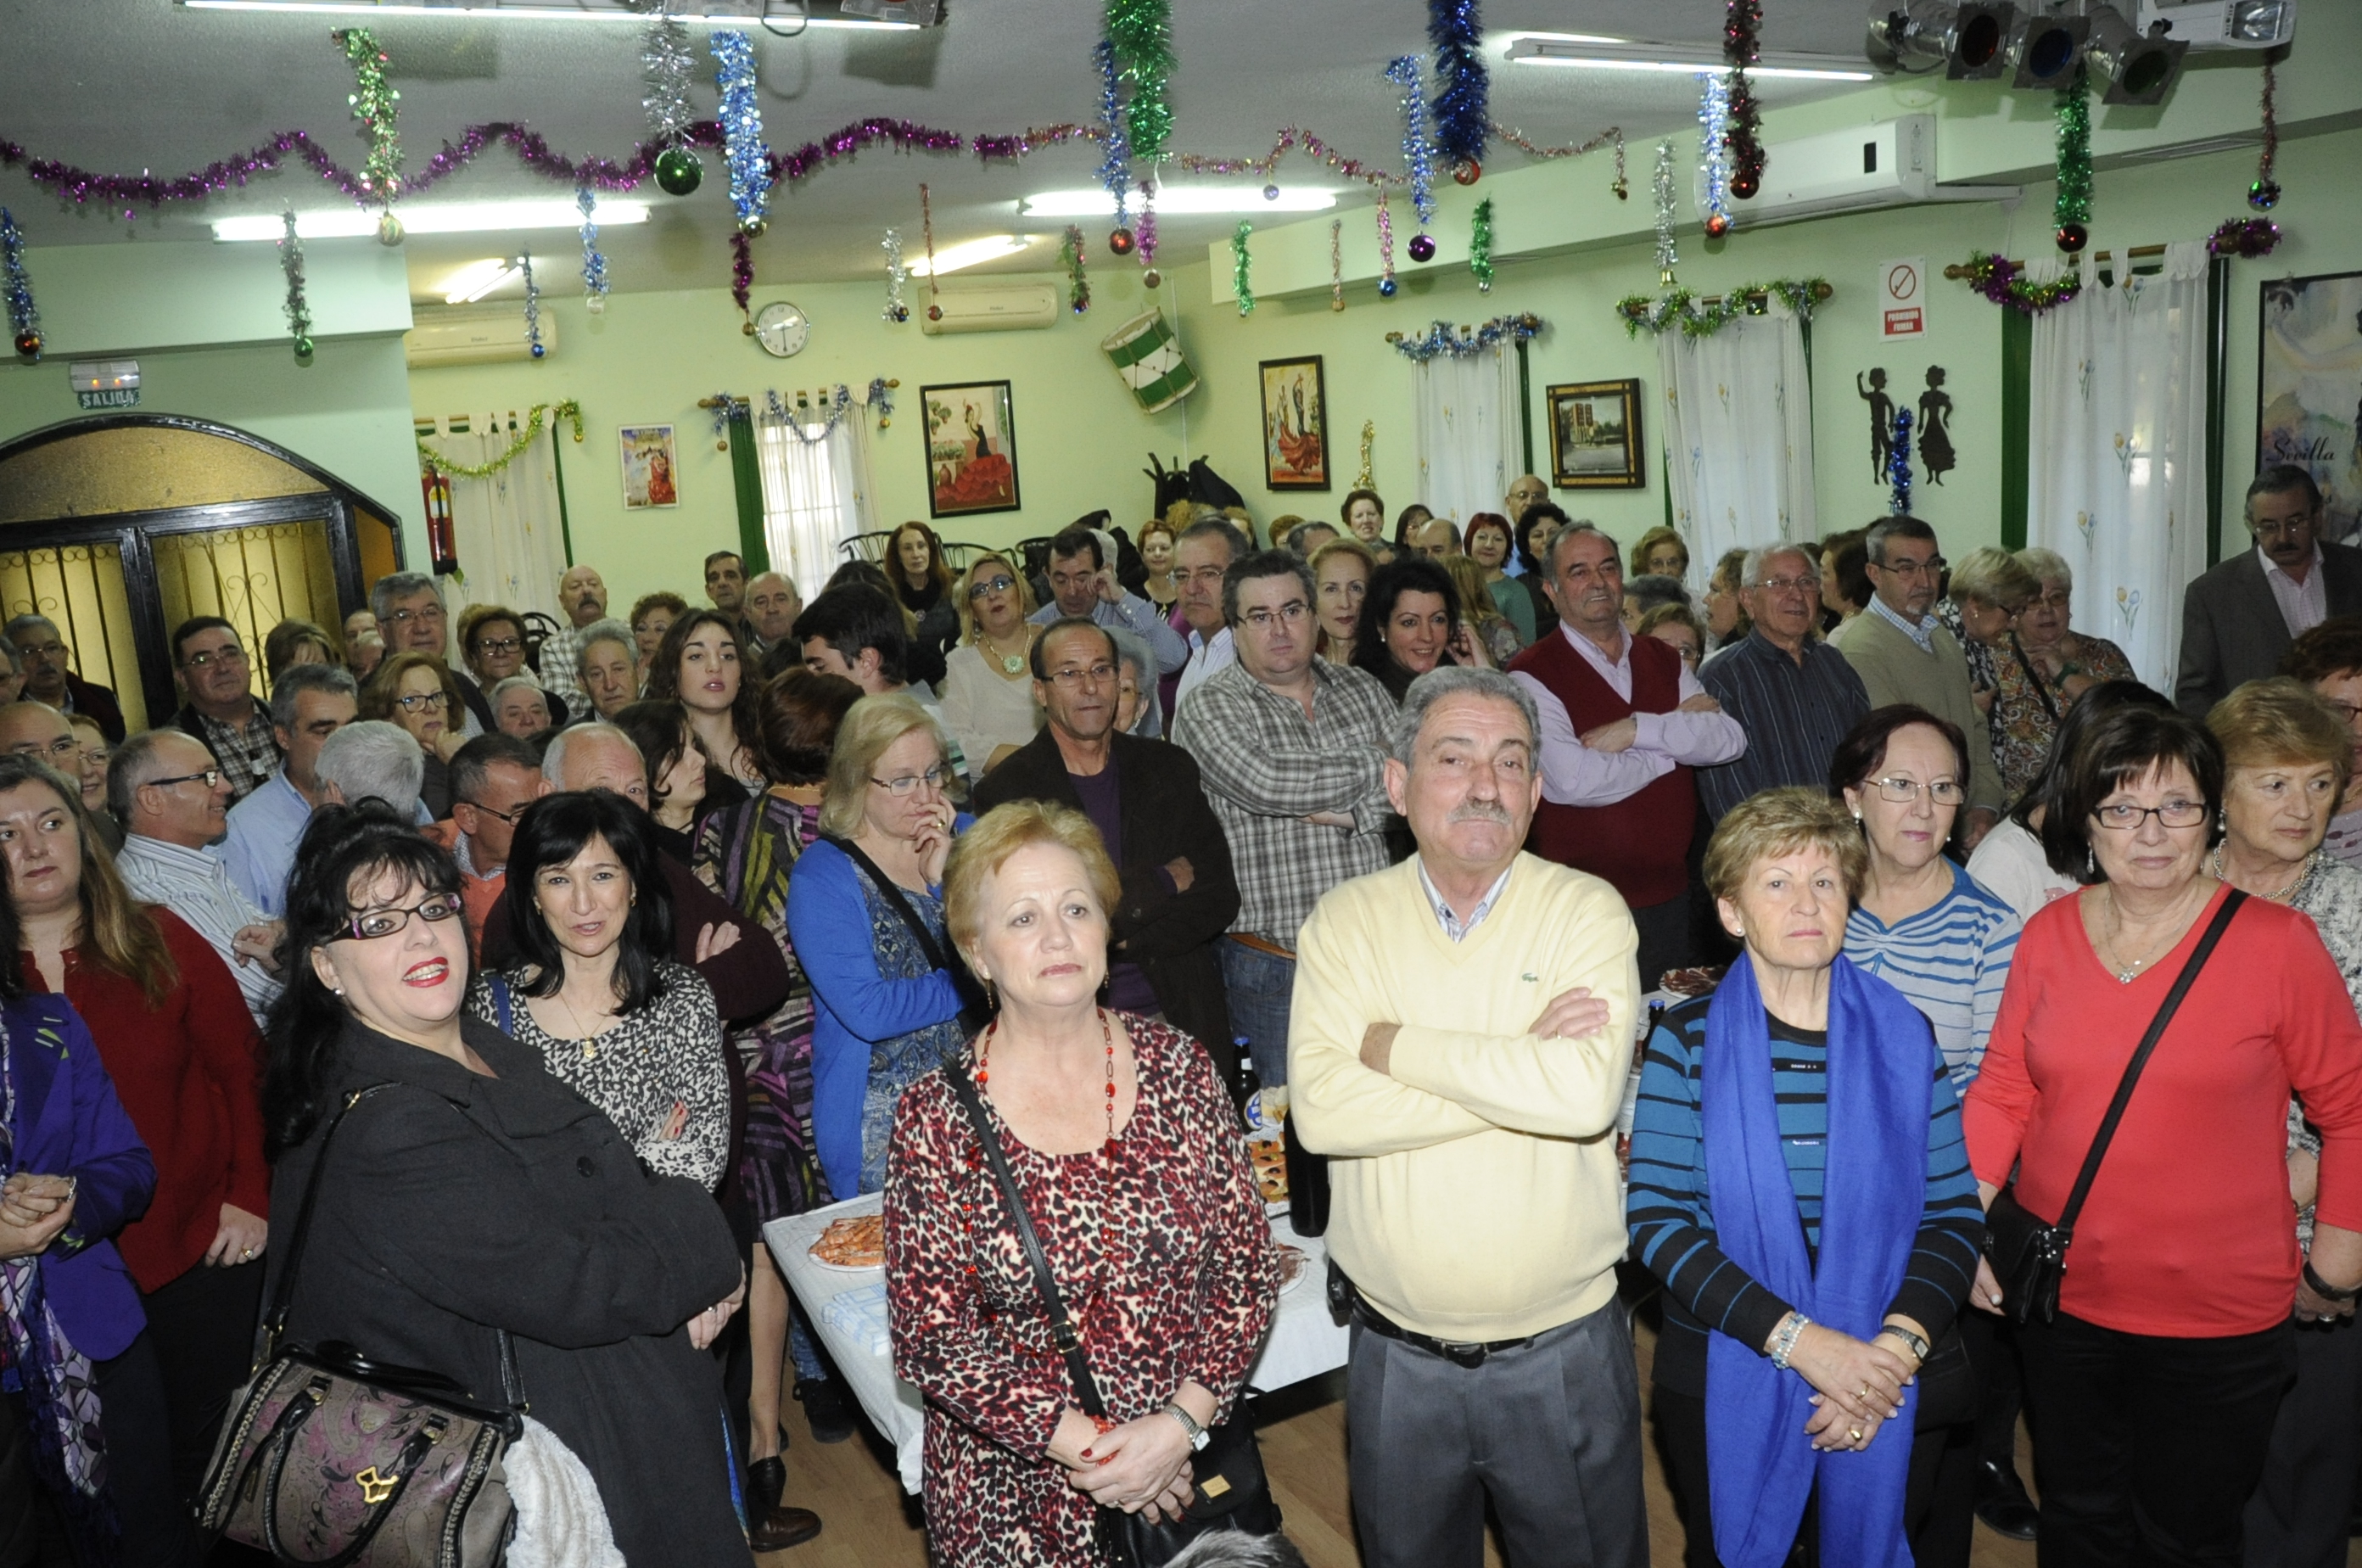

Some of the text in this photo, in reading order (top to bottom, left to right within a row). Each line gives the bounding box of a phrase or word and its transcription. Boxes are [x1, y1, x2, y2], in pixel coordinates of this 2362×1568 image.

[1893, 322, 1914, 332] FUMAR
[81, 390, 135, 407] SALIDA
[2265, 436, 2335, 461] Sevilla
